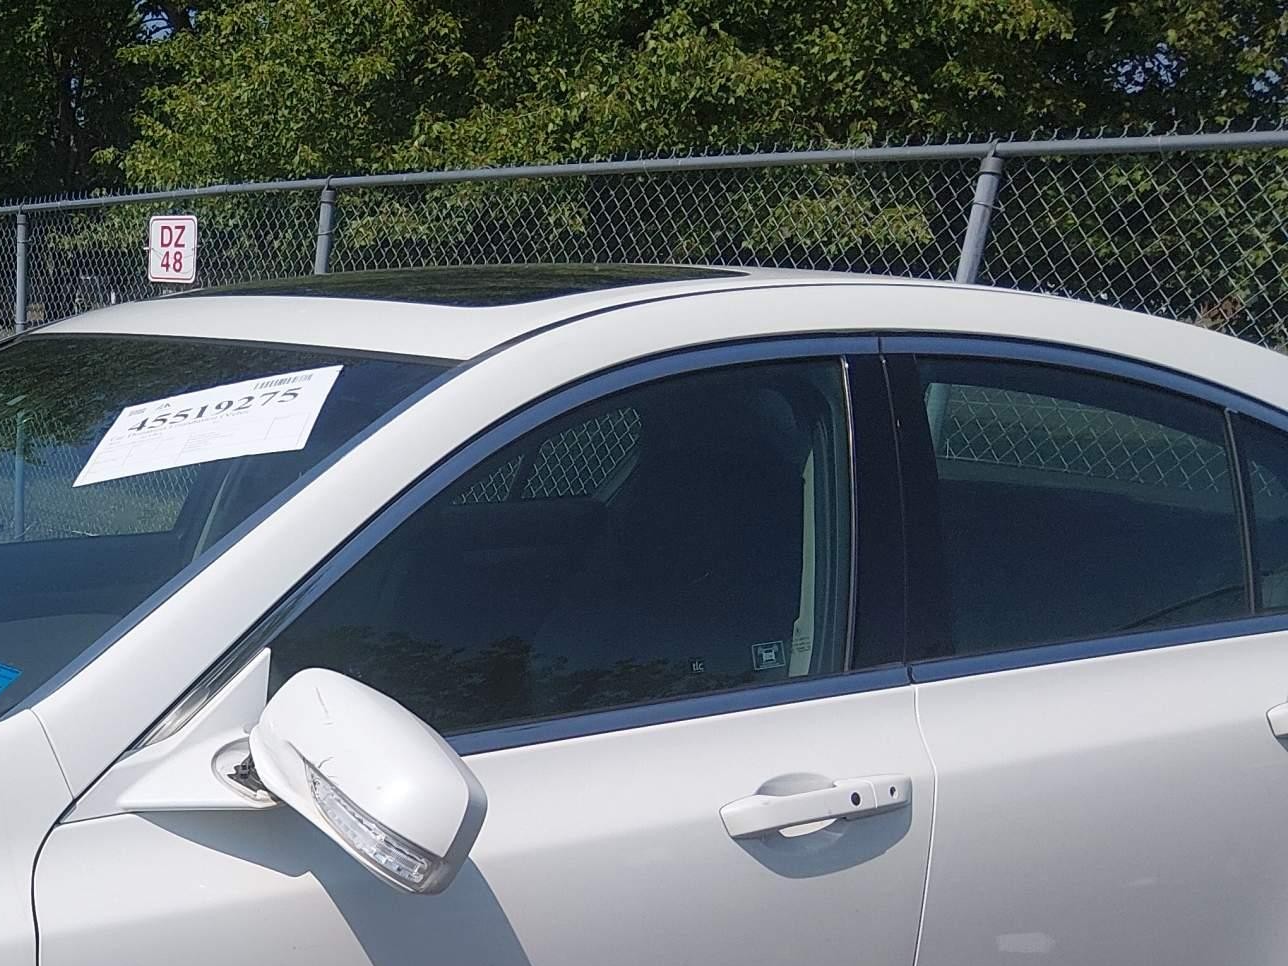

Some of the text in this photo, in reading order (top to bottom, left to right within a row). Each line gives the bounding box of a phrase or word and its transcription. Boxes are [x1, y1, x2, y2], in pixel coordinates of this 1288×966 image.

[160, 225, 186, 248] DZ
[160, 250, 183, 273] 48
[127, 386, 303, 432] 45519275
